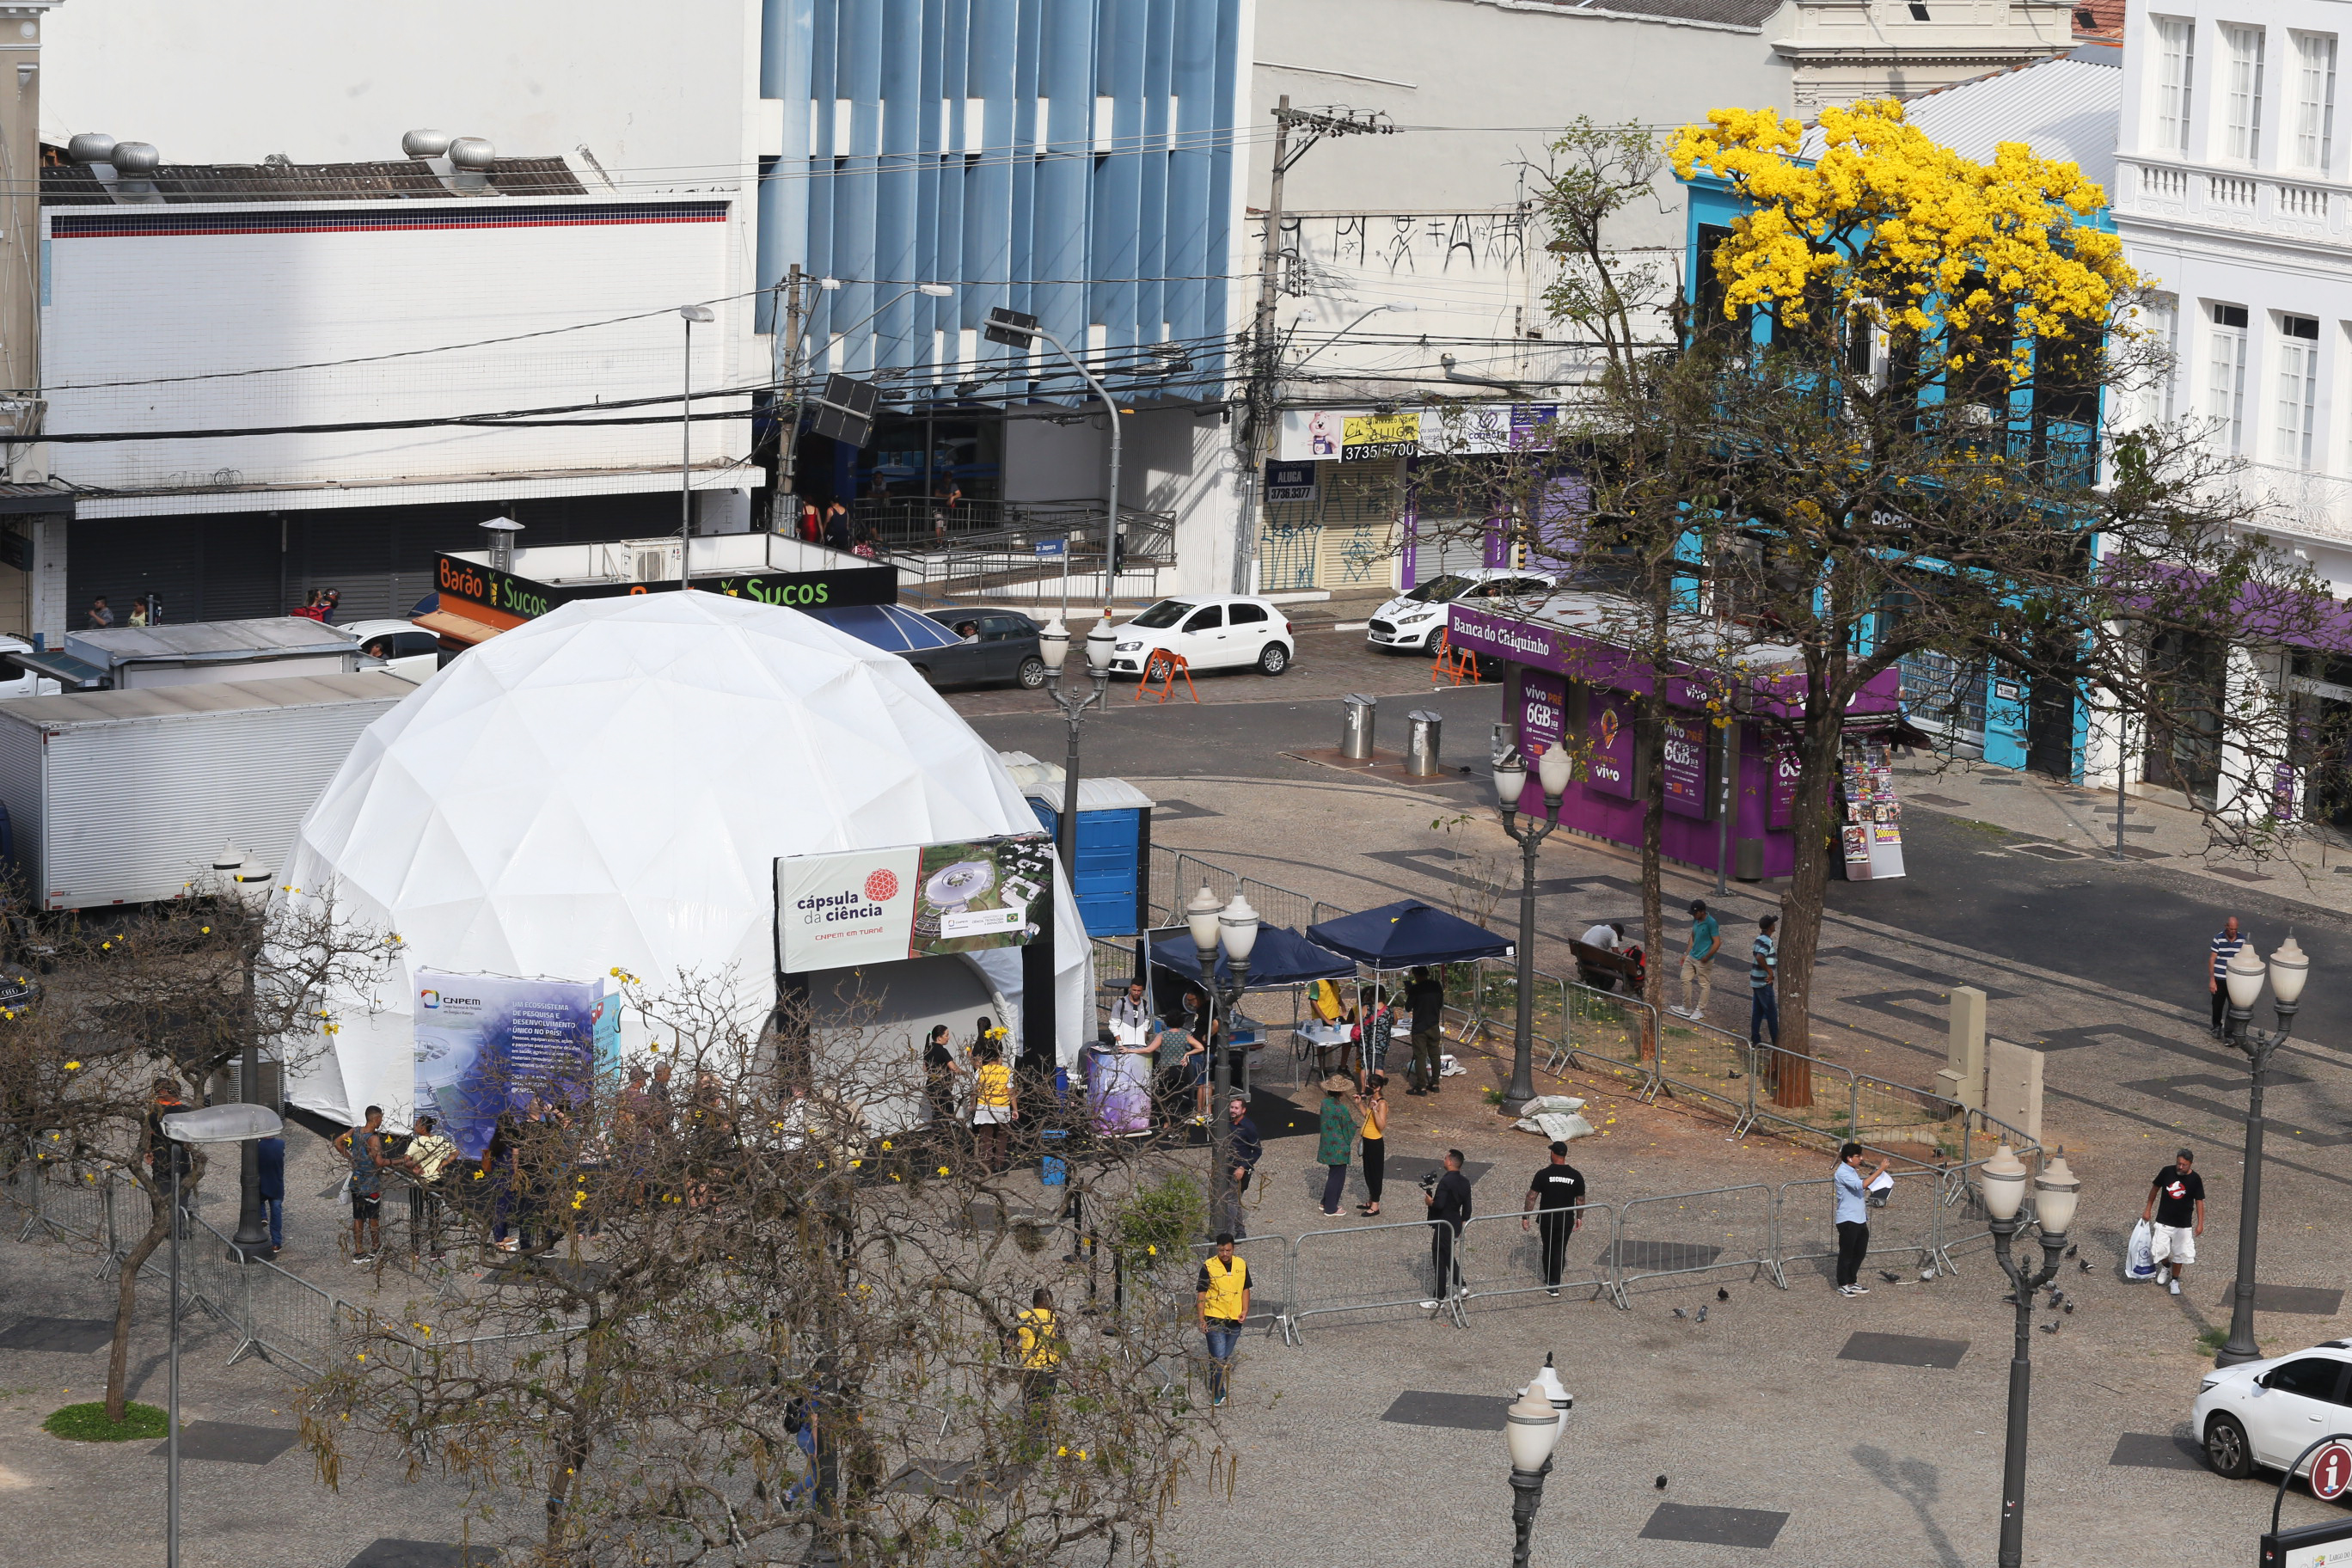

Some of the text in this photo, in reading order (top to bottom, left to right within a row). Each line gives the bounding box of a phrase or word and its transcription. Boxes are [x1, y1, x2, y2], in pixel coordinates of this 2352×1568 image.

[1277, 471, 1302, 483] ALUGA
[1271, 487, 1310, 499] 3736.3377
[440, 558, 548, 616] Barão Sucos
[746, 579, 828, 605] Sucos
[1454, 616, 1483, 638] Banca
[1484, 624, 1496, 641] do
[1498, 628, 1549, 656] Chiquinho
[1525, 684, 1563, 706] vivo PRÉ
[1527, 701, 1551, 727] 6GB
[1664, 739, 1690, 765] 6GB
[1596, 763, 1620, 782] vivo
[798, 890, 859, 911] cápsula
[804, 903, 882, 924] da ciência
[815, 932, 844, 940] CNPEM
[860, 926, 884, 935] TURNÊ
[443, 997, 481, 1006] CNPEM
[524, 1001, 569, 1011] ECOSSISTEMA
[523, 1010, 554, 1019] PESQUISA
[512, 1018, 576, 1029] DESENVOLVIMENTO
[512, 1026, 533, 1034] ÚNICO
[1549, 1176, 1575, 1185] SECURITY
